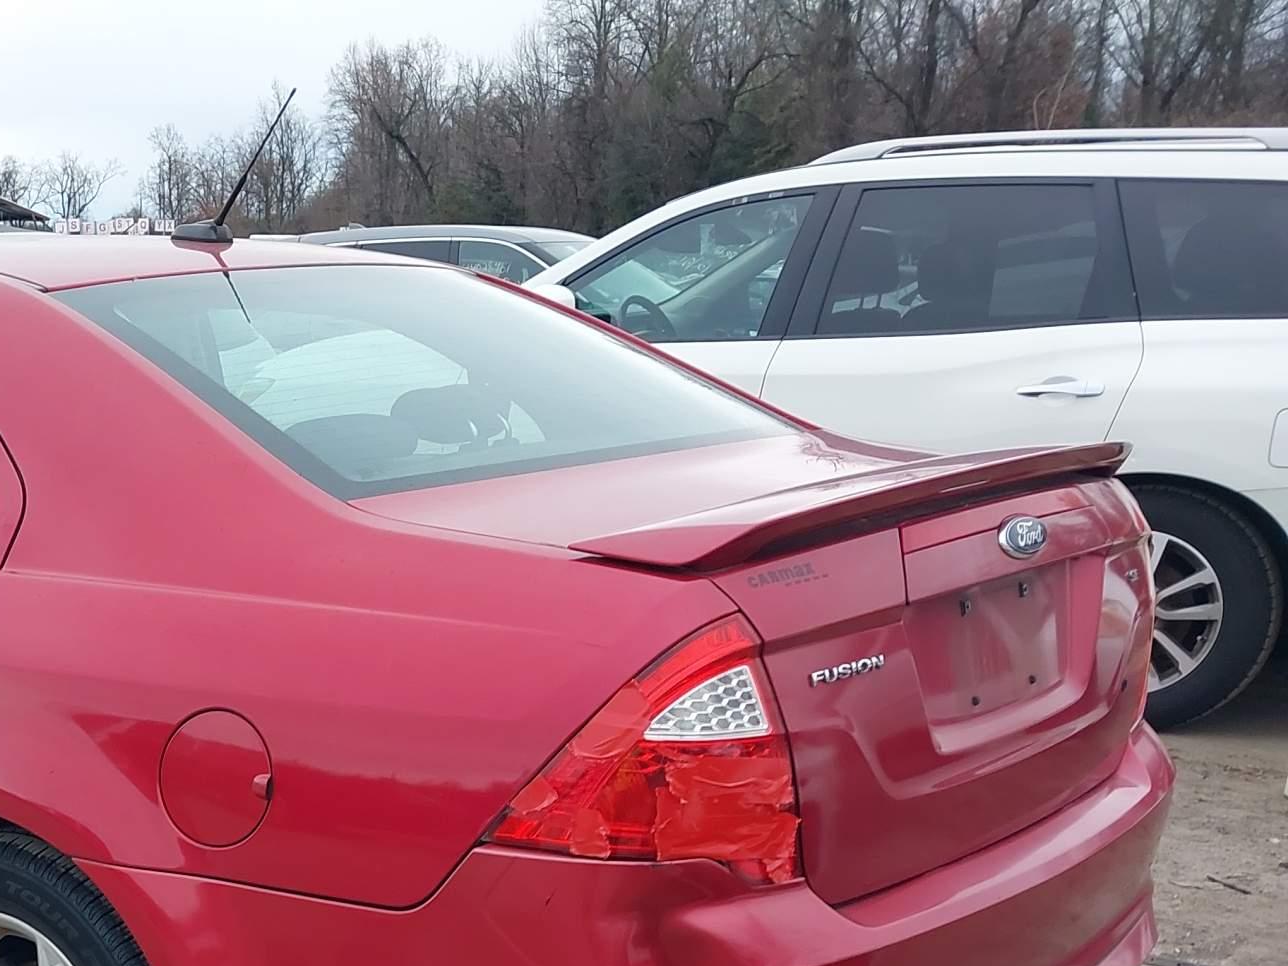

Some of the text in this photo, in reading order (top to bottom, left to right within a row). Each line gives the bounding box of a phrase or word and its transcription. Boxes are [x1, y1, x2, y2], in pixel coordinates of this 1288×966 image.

[70, 220, 78, 230] S
[98, 222, 107, 232] G
[1016, 521, 1044, 547] Ford
[810, 654, 885, 688] FUSION
